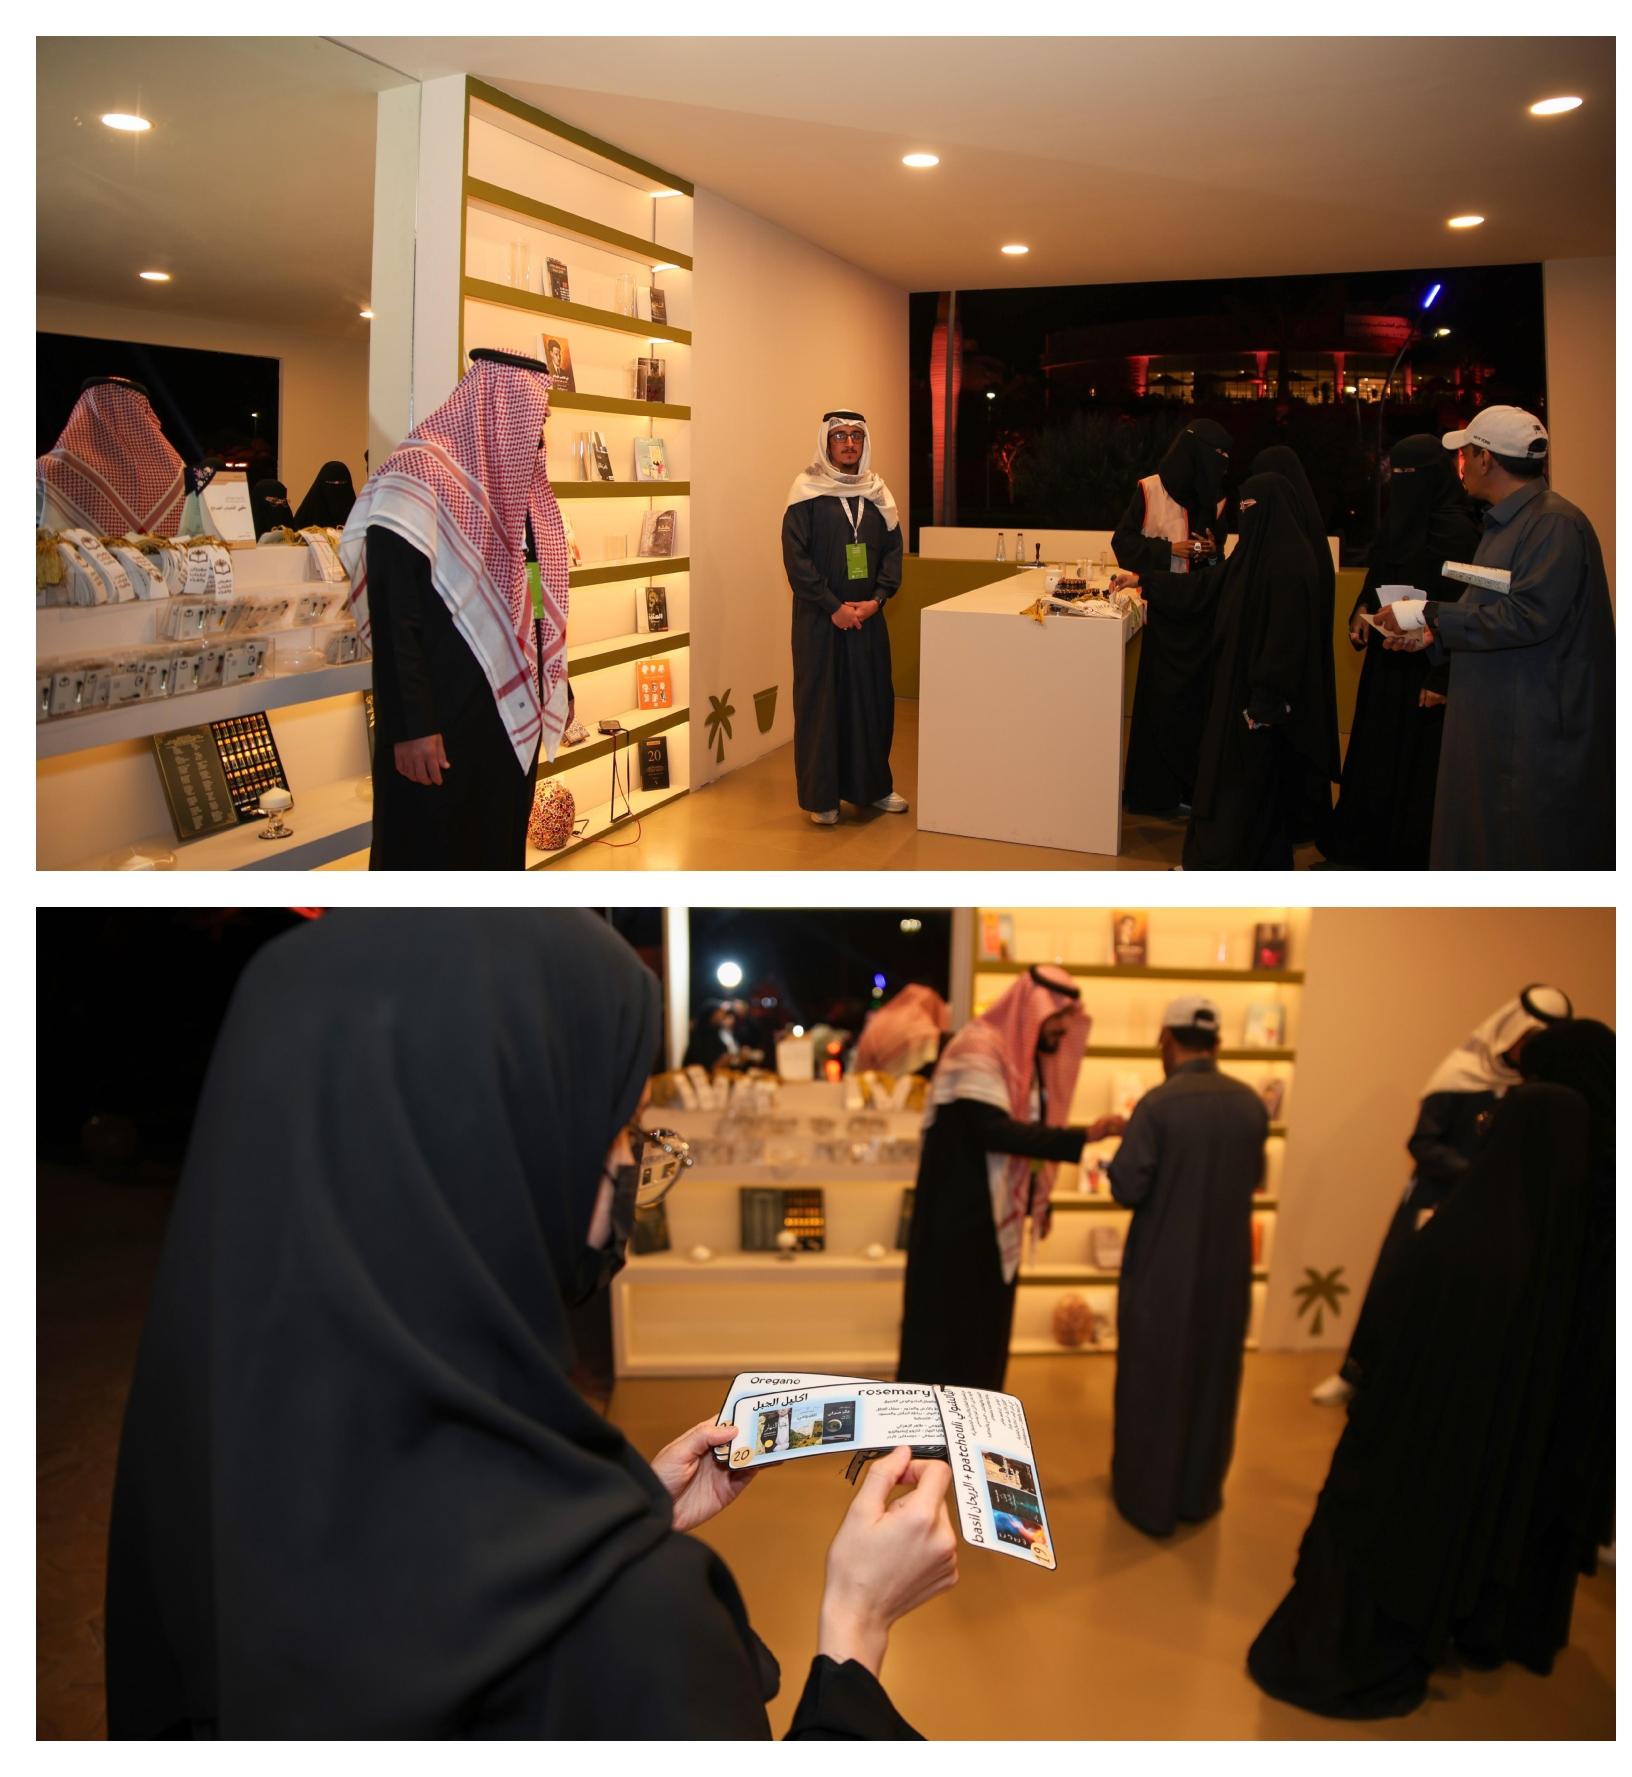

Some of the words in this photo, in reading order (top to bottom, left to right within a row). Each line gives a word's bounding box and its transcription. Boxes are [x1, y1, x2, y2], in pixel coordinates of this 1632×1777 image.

[647, 750, 662, 763] 20
[750, 1376, 801, 1385] Oregano
[858, 1388, 931, 1398] rosemary
[752, 1398, 780, 1411] الجبل
[781, 1393, 808, 1407] اكليل
[950, 1421, 975, 1474] patchouli
[733, 1449, 750, 1462] 20
[962, 1482, 982, 1514] الريحان
[967, 1513, 985, 1544] basil
[1032, 1545, 1051, 1564] 19
